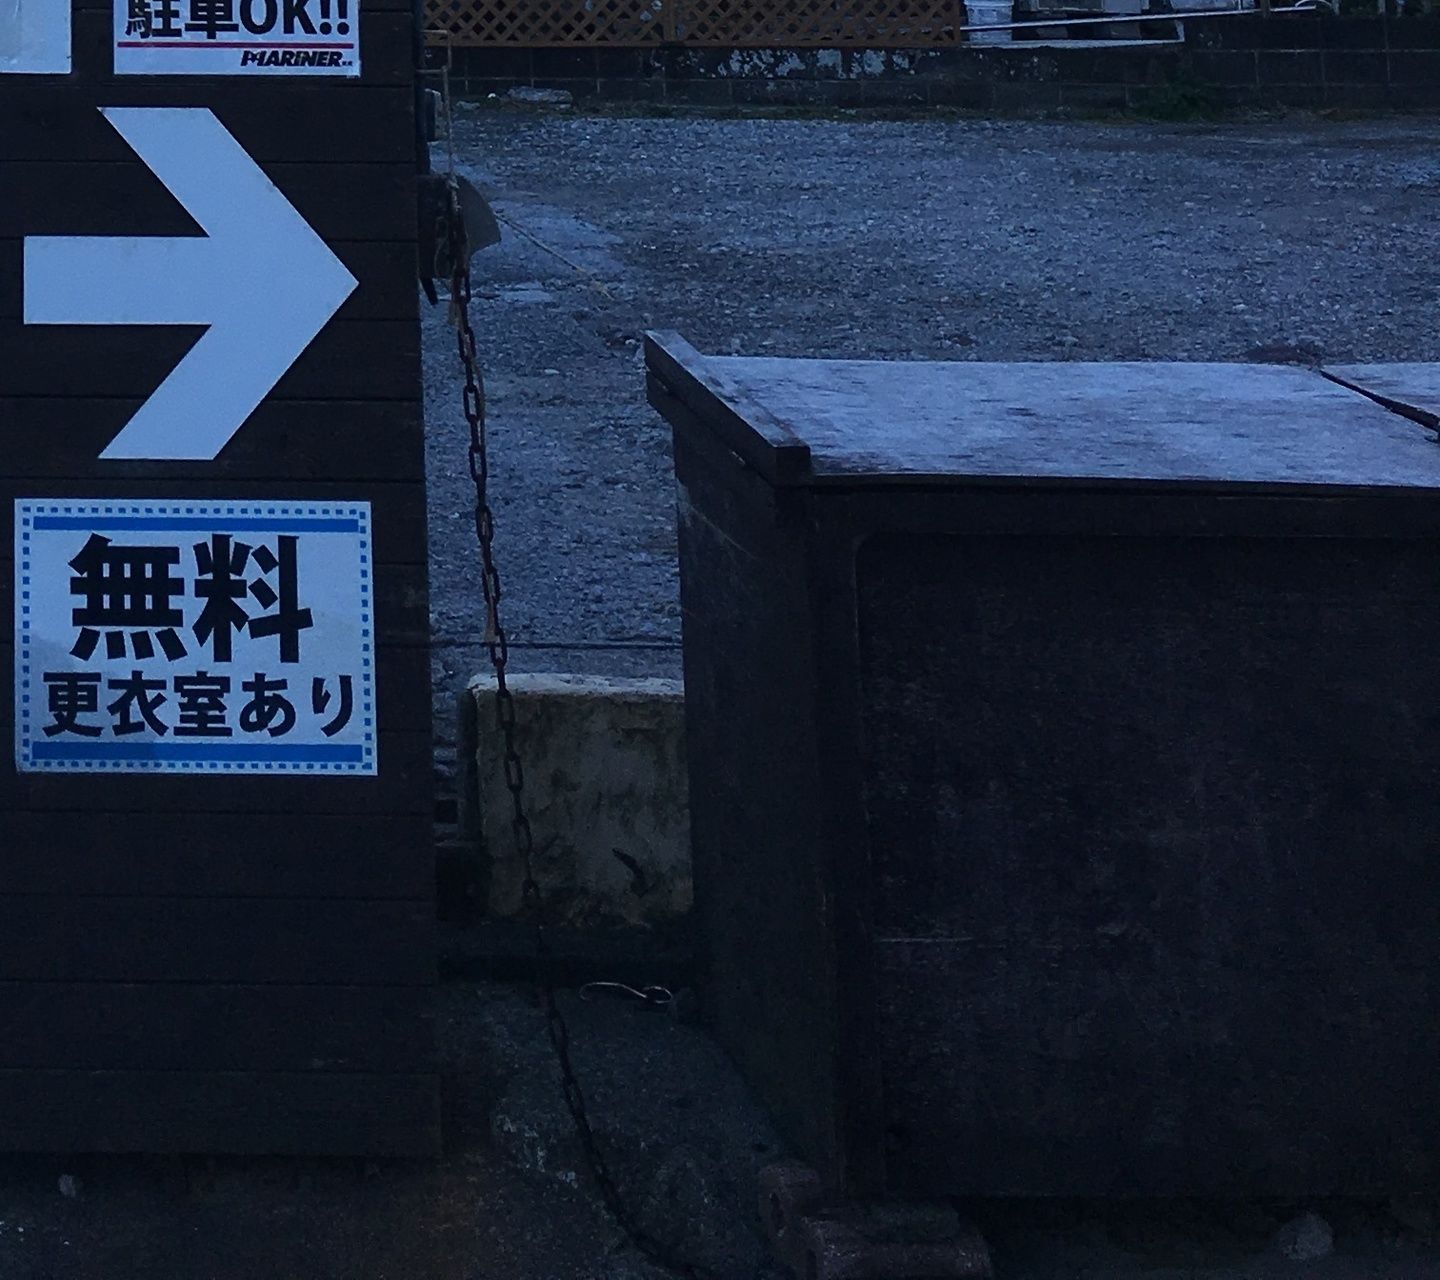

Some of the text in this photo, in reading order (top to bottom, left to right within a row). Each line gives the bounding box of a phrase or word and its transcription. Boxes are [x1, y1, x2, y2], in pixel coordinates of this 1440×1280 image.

[68, 532, 314, 663] 無料
[42, 672, 353, 737] 更衣室あり
